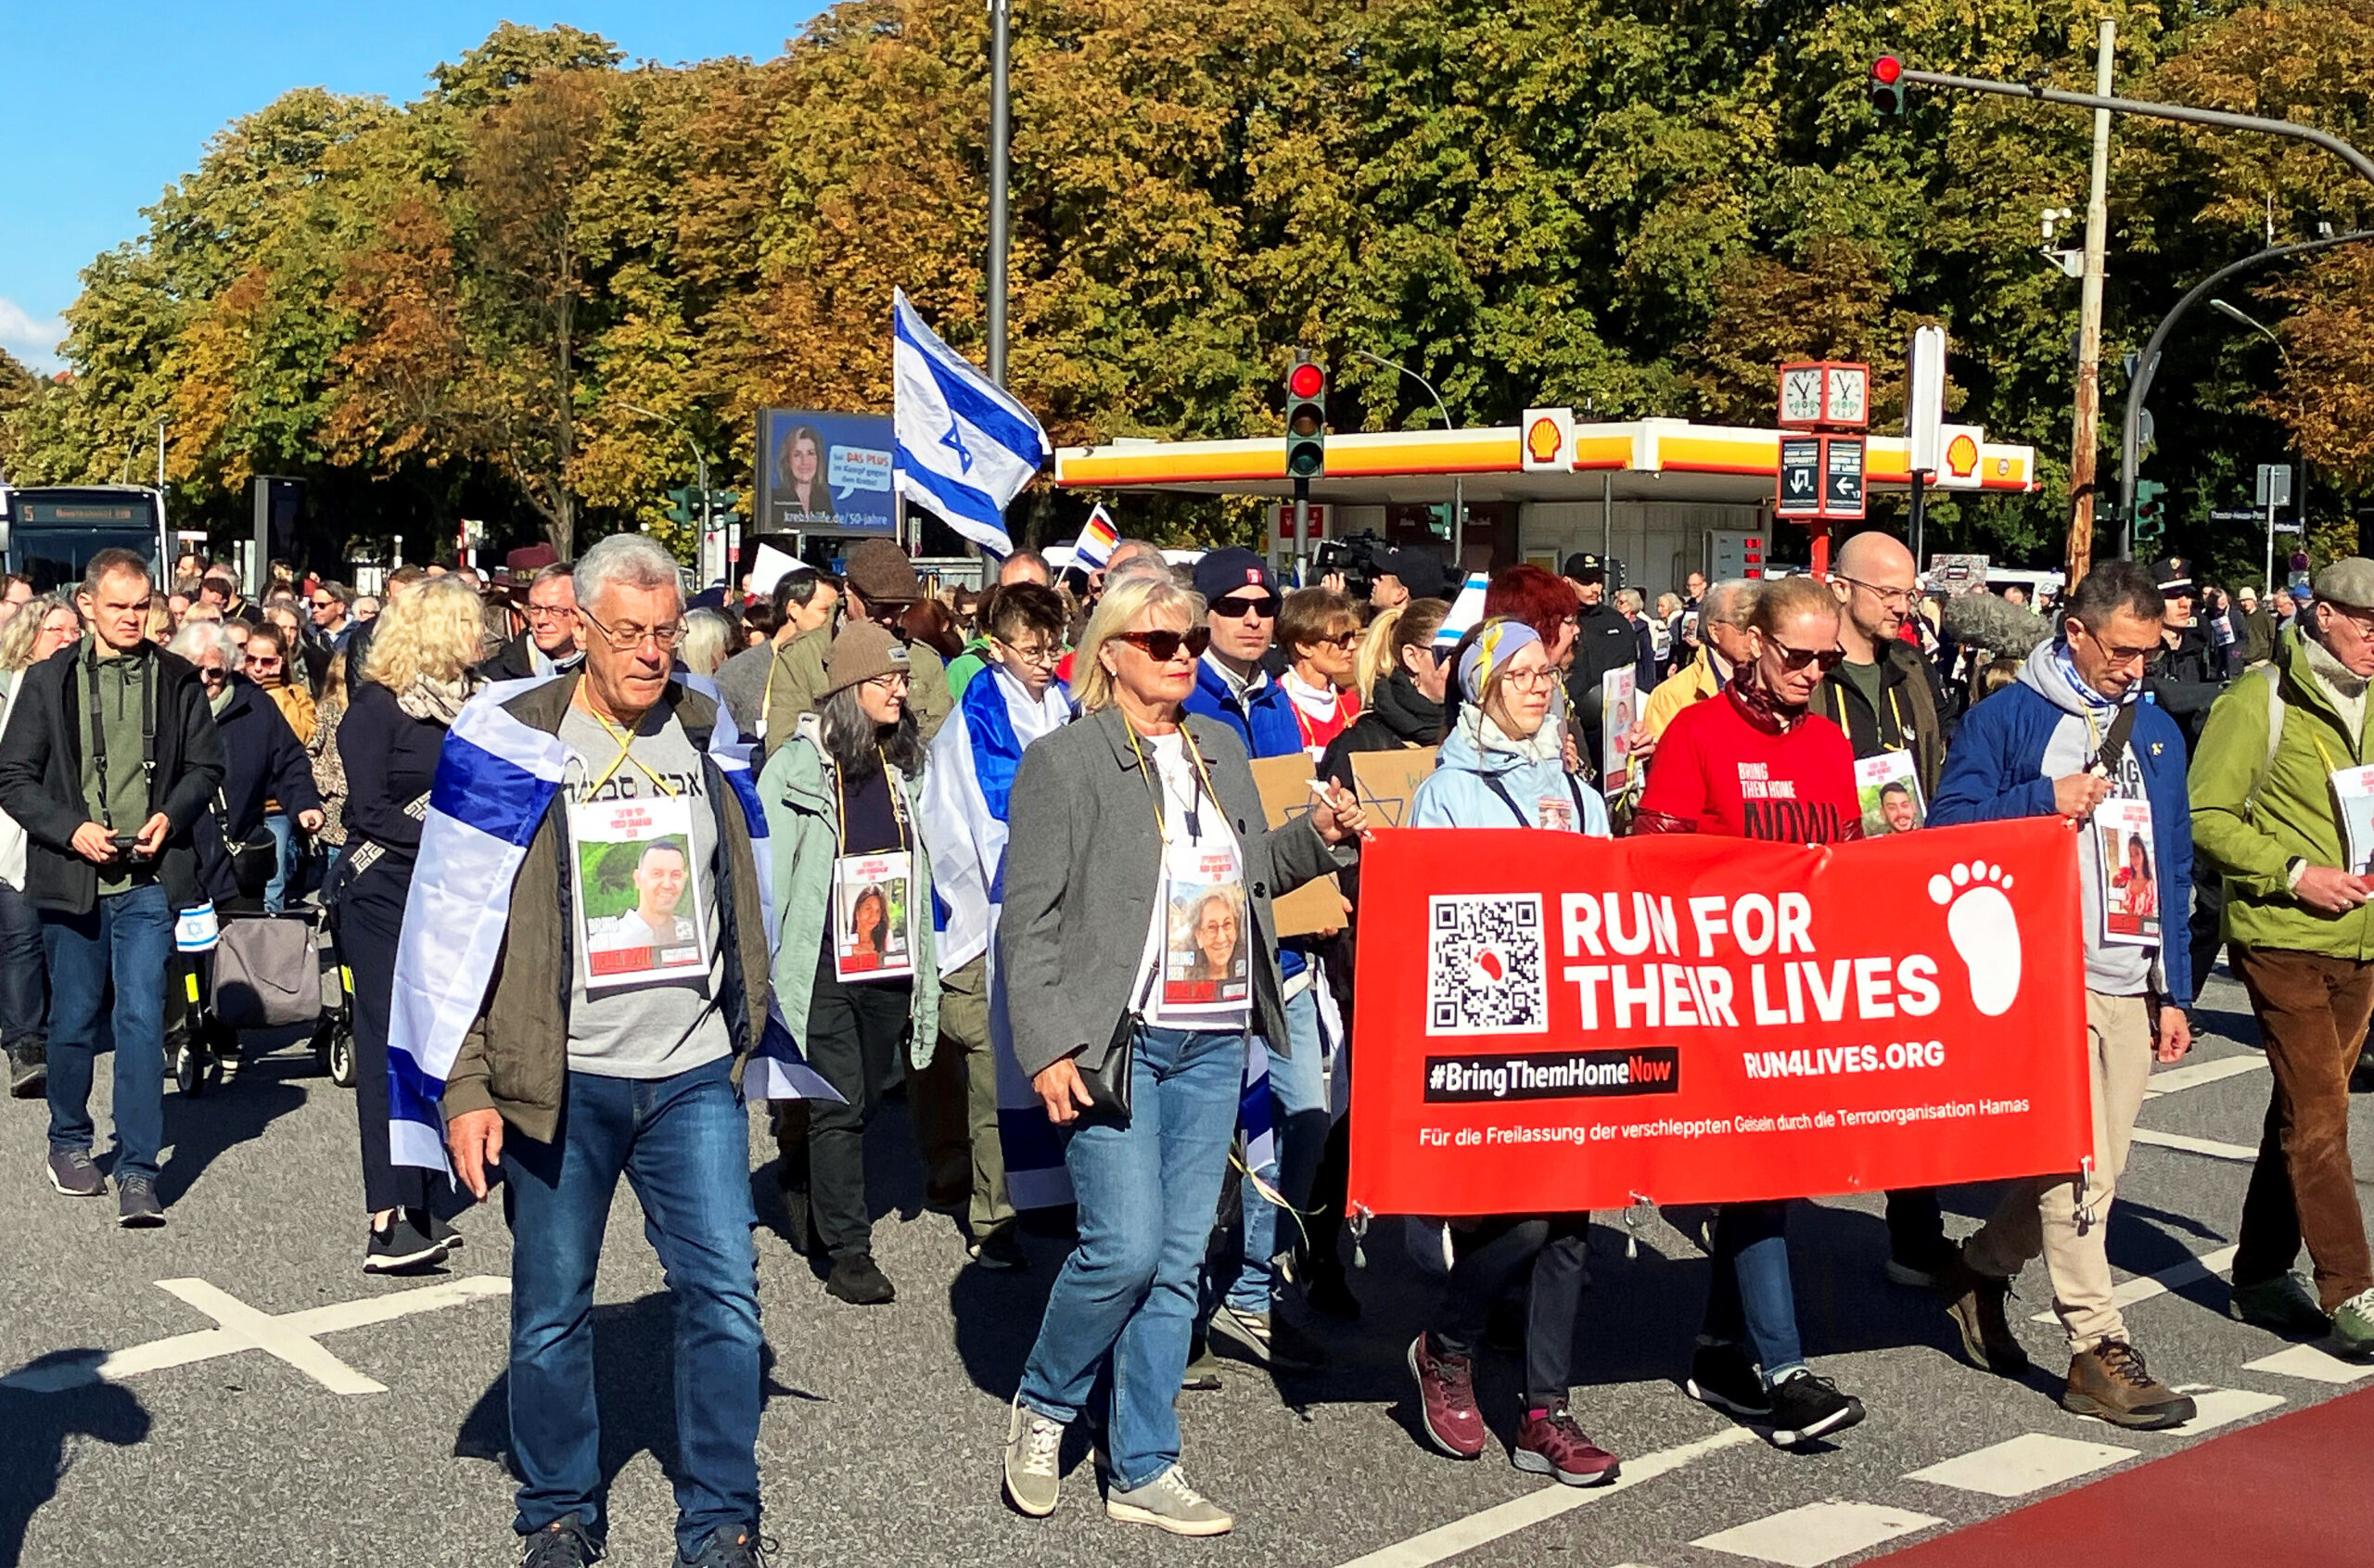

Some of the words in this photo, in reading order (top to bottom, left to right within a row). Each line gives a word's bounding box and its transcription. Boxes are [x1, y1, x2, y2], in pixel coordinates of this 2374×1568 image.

[847, 452, 863, 464] DAS
[867, 454, 889, 467] PLUS
[1738, 762, 1768, 781] BRING
[1740, 781, 1768, 798] THEM
[1768, 780, 1796, 798] HOME
[1561, 892, 1679, 957] RUN
[1688, 892, 1816, 957] FOR
[1564, 962, 1740, 1030] THEIR
[1752, 954, 1941, 1026] LIVES
[1429, 1055, 1671, 1097] #BringThemHomeNow
[1743, 1040, 1945, 1078] RUN4LIVES.ORG
[1420, 1128, 1449, 1146] Für
[1455, 1128, 1482, 1146] die
[1487, 1125, 1585, 1145] Freilassung
[1590, 1122, 1617, 1141] der
[1622, 1116, 1731, 1140] verschleppten
[1734, 1114, 1776, 1133] Geiseln
[1777, 1112, 1813, 1132] durch
[1815, 1110, 1835, 1128] die
[1837, 1101, 1975, 1126] Terrororganisation
[1979, 1098, 2030, 1115] Hamas
